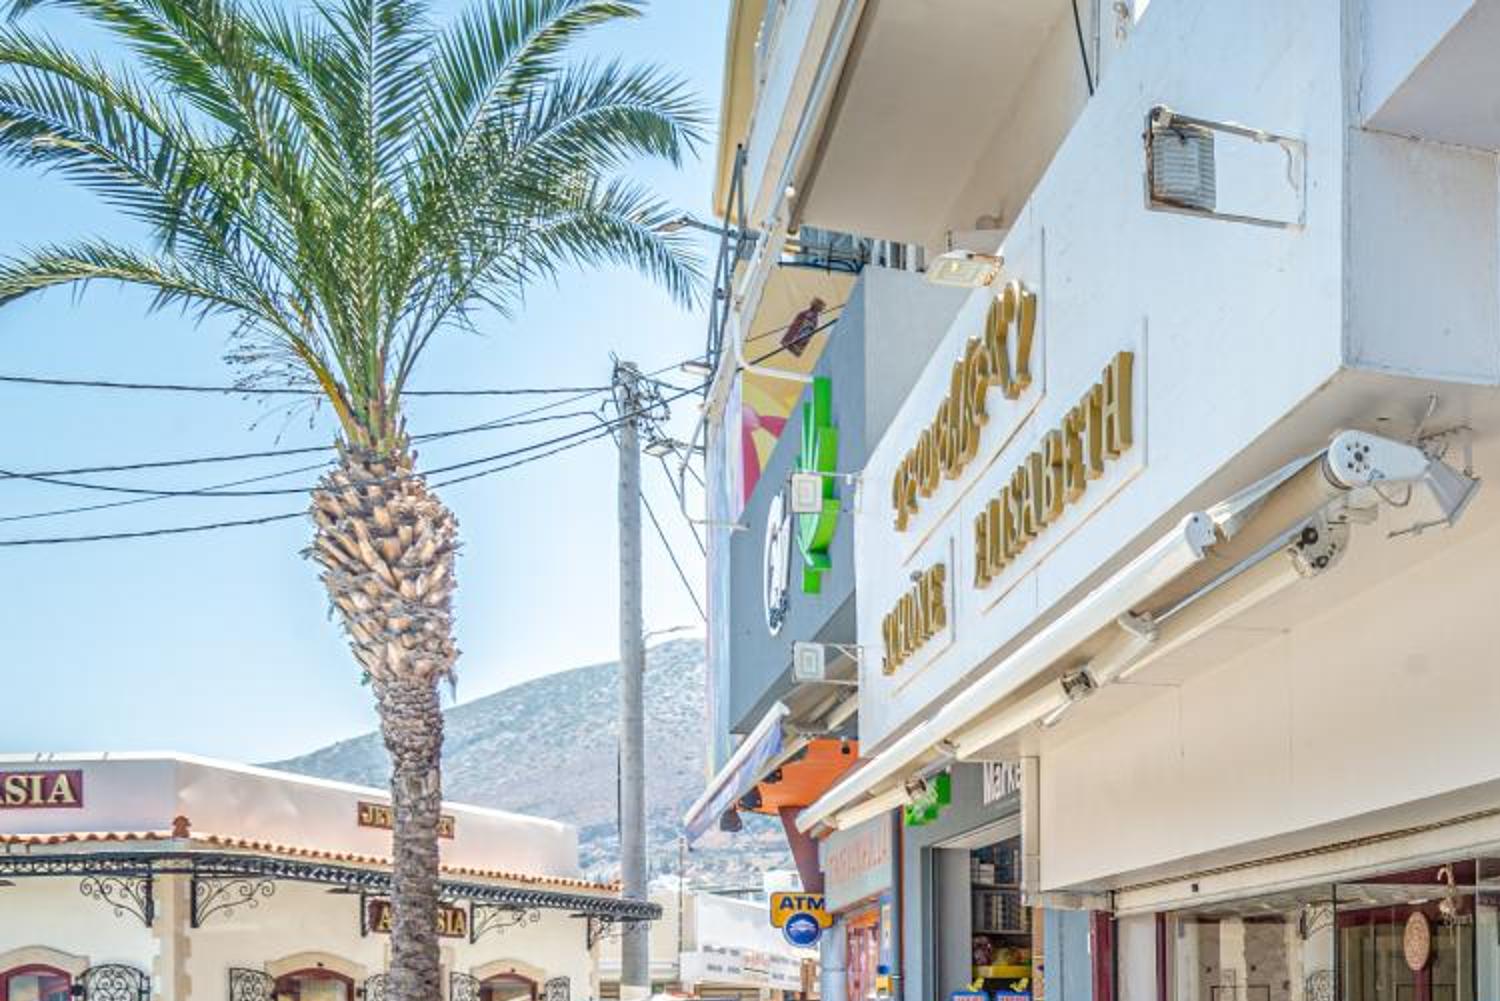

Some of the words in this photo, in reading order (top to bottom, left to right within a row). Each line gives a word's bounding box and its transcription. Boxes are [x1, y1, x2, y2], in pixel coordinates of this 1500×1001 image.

[974, 351, 1135, 589] ELISABETH
[0, 773, 77, 805] SIA
[983, 759, 1022, 806] Marke
[779, 895, 826, 909] ATM
